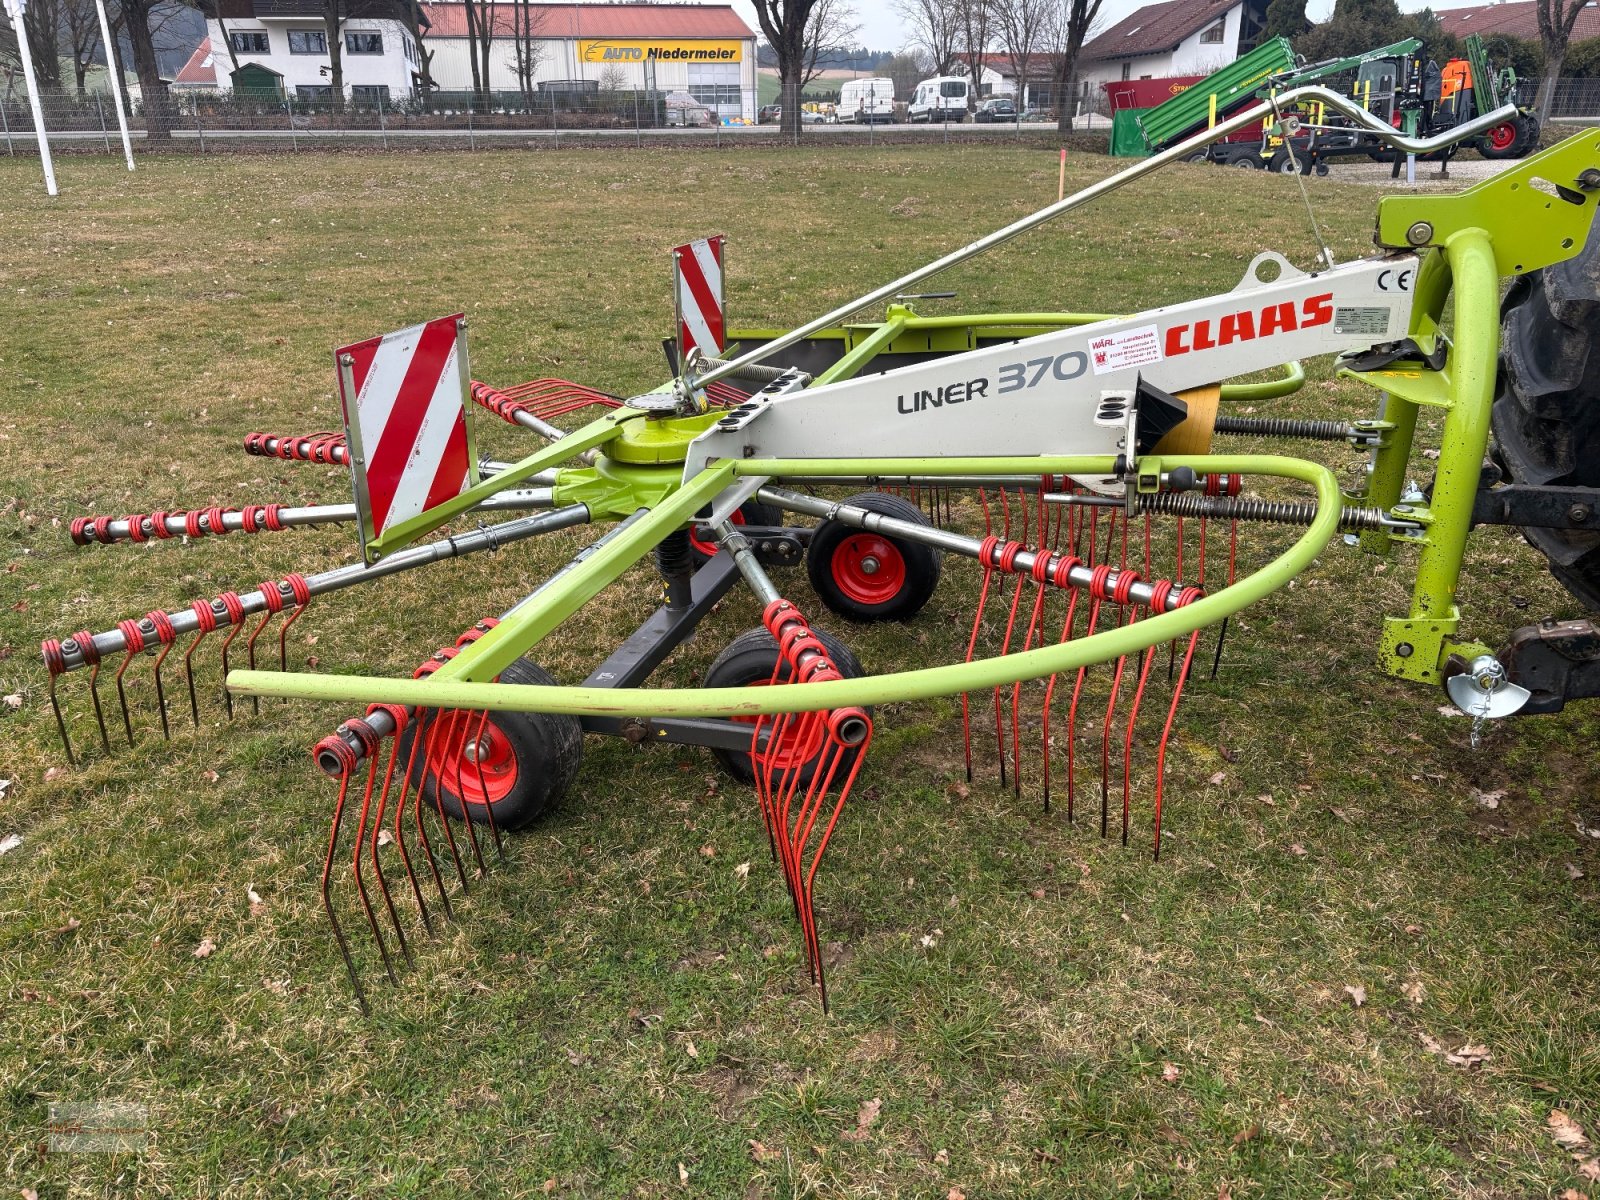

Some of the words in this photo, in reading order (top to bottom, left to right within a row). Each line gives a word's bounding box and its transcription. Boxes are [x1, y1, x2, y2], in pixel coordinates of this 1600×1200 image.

[603, 48, 642, 59] AUTO
[647, 47, 736, 59] Niedermeier
[1165, 293, 1333, 357] CLAAS
[897, 378, 988, 415] LINER
[998, 351, 1088, 394] 370
